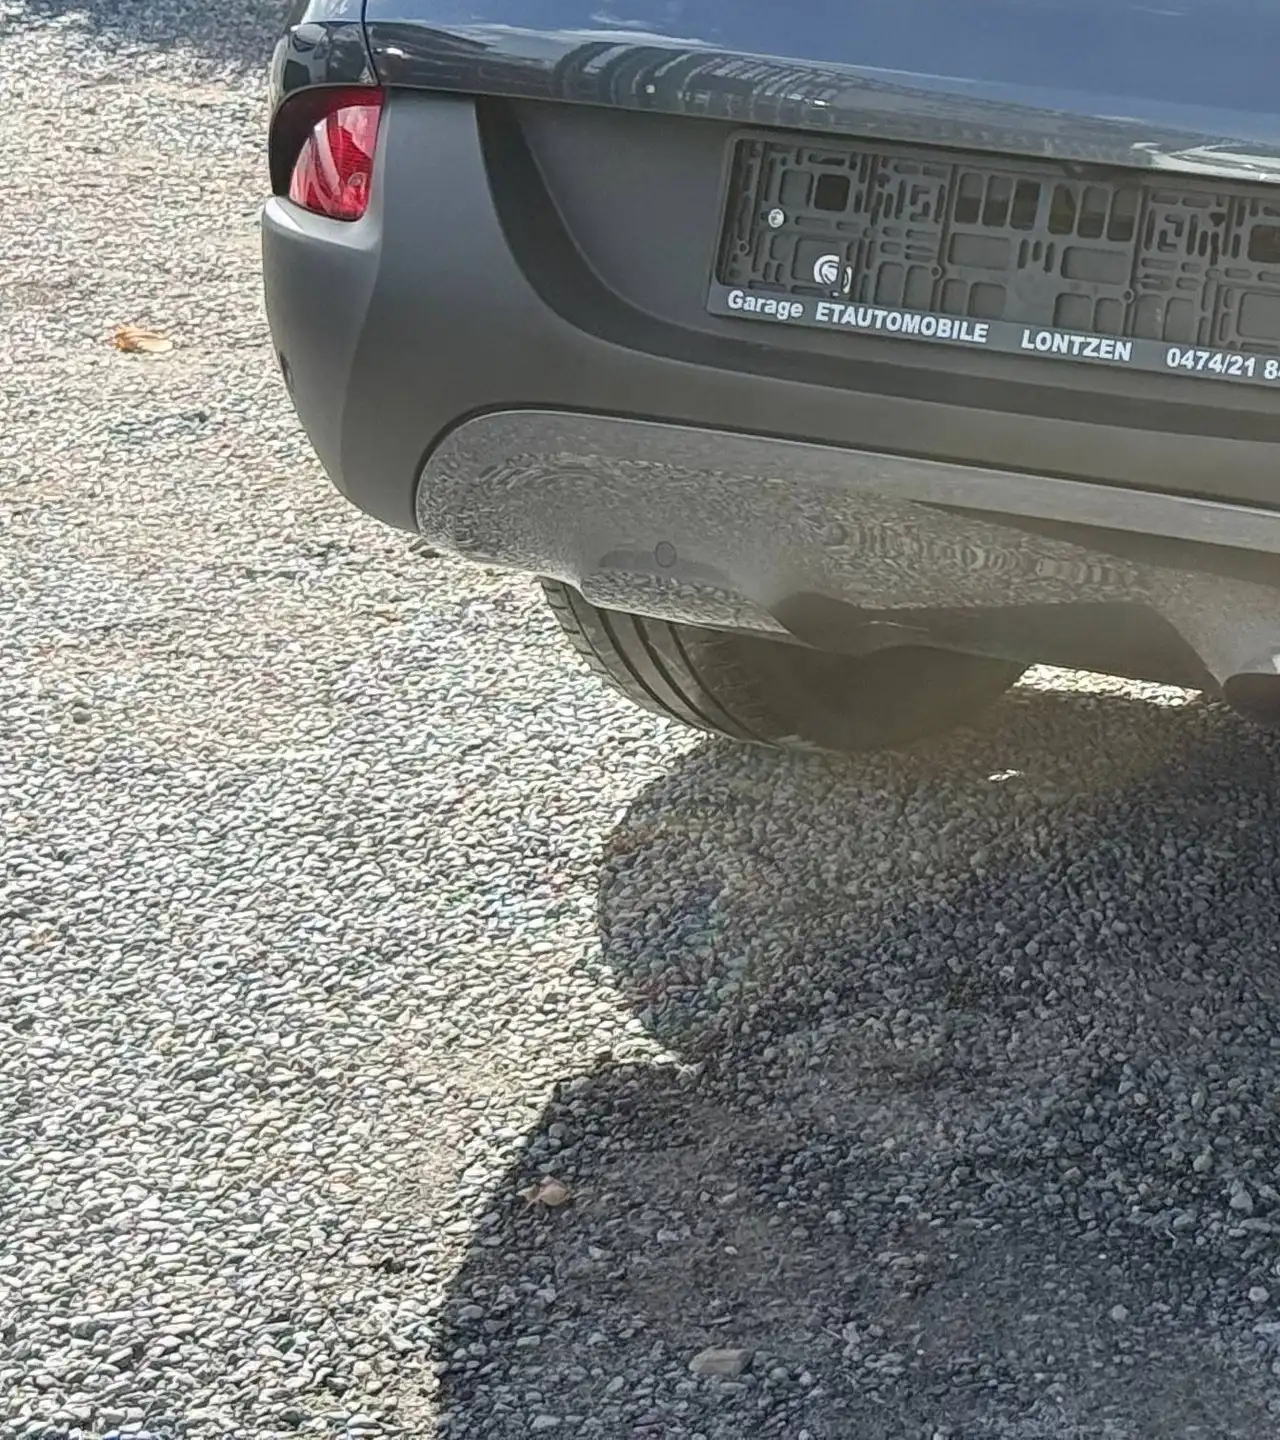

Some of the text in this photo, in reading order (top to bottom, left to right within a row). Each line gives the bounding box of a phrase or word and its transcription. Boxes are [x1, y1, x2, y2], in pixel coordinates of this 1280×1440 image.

[727, 290, 803, 320] Garage
[815, 302, 989, 343] ETAUTOMOBILE
[1021, 329, 1133, 362] LONTZEN
[1166, 347, 1256, 377] 0474/21
